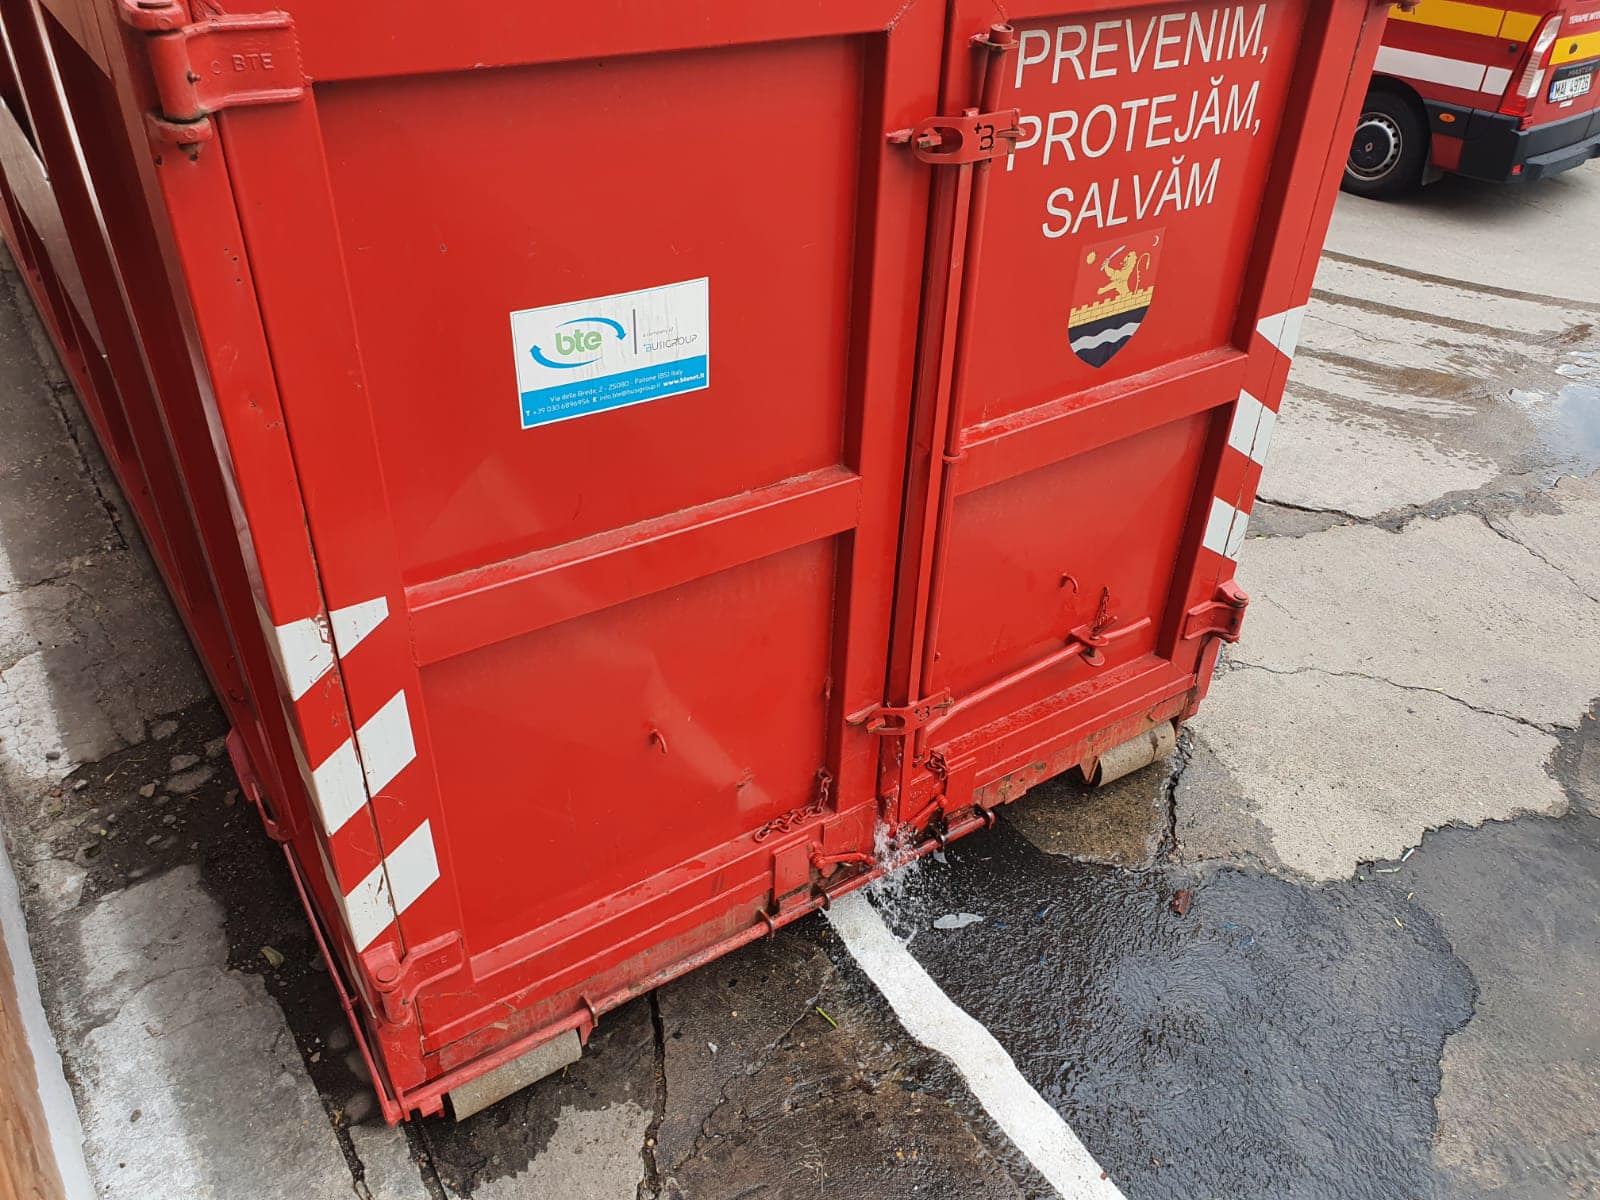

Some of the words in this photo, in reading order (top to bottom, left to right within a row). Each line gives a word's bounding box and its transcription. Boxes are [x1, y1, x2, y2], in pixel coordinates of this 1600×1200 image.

[231, 53, 274, 72] BTE
[1014, 3, 1268, 89] PREVENIM,
[1006, 74, 1261, 172] PROTEJĂM,
[1042, 154, 1221, 239] SALVĂM
[554, 329, 602, 356] bte
